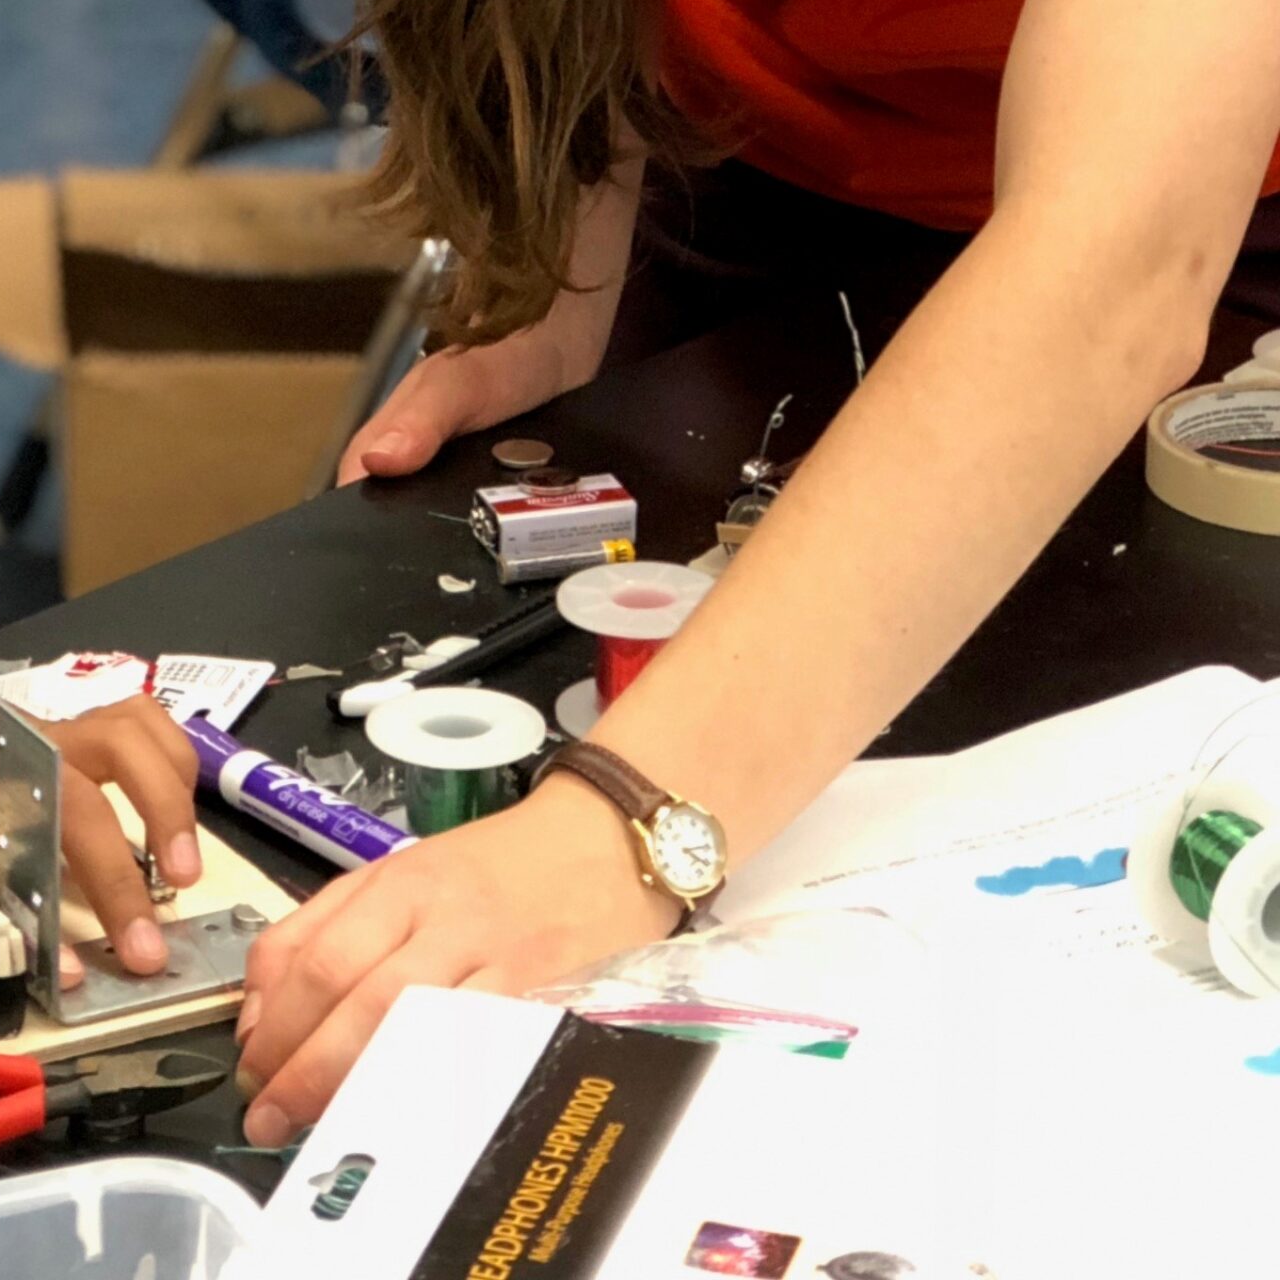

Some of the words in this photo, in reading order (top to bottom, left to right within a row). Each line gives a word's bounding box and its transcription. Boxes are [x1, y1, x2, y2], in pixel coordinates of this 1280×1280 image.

[466, 1158, 569, 1280] EADPHONES
[539, 1077, 616, 1162] HPM1000
[571, 1122, 625, 1189] Headphones
